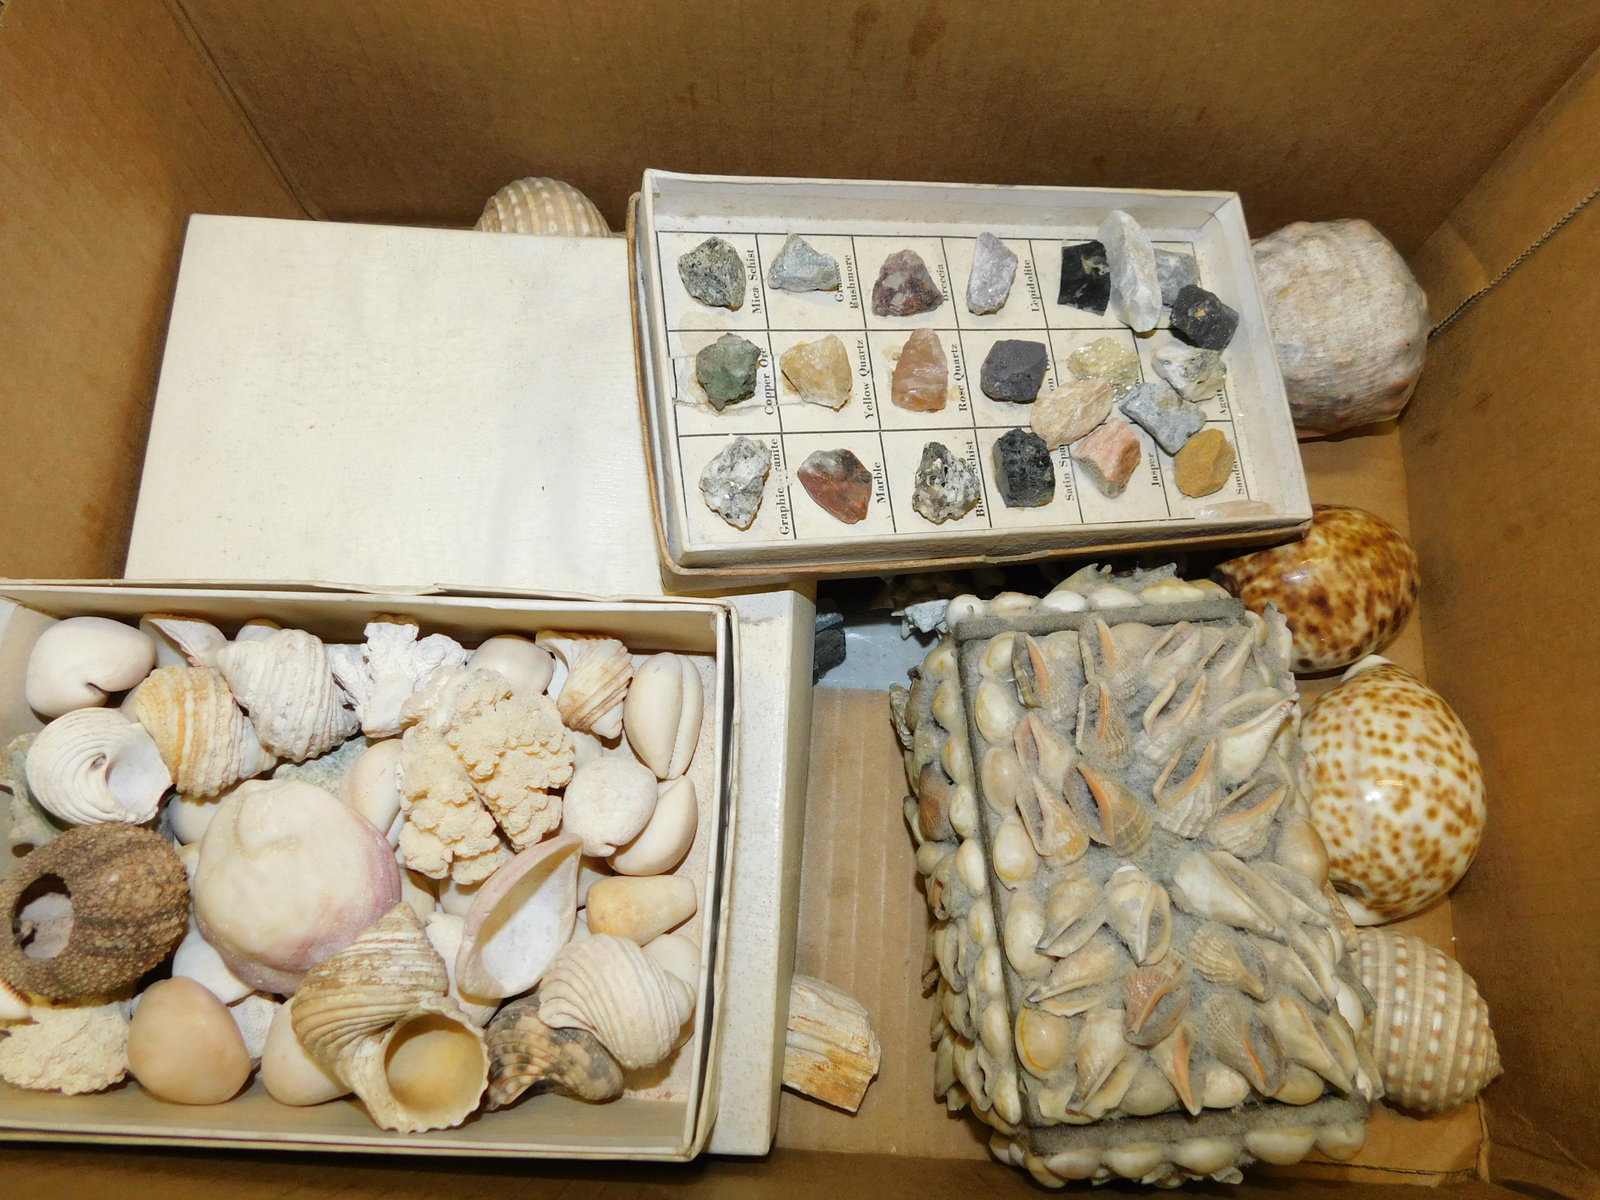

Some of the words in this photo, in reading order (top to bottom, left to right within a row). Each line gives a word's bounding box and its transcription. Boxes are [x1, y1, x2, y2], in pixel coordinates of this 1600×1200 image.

[747, 249, 758, 281] Schist
[845, 254, 859, 309] Rushmore
[751, 286, 762, 314] Mica
[1024, 259, 1040, 312] Lepidolite
[758, 348, 770, 368] Ore
[856, 339, 869, 377] Quartz
[950, 343, 964, 381] Quartz
[764, 373, 776, 415] Copper
[862, 382, 875, 420] Yellow
[958, 384, 968, 412] Rose
[770, 438, 781, 474] ranite
[1148, 452, 1161, 487] Jasper
[873, 462, 887, 504] Marble
[1063, 472, 1074, 502] Satin
[776, 487, 789, 536] Graphic
